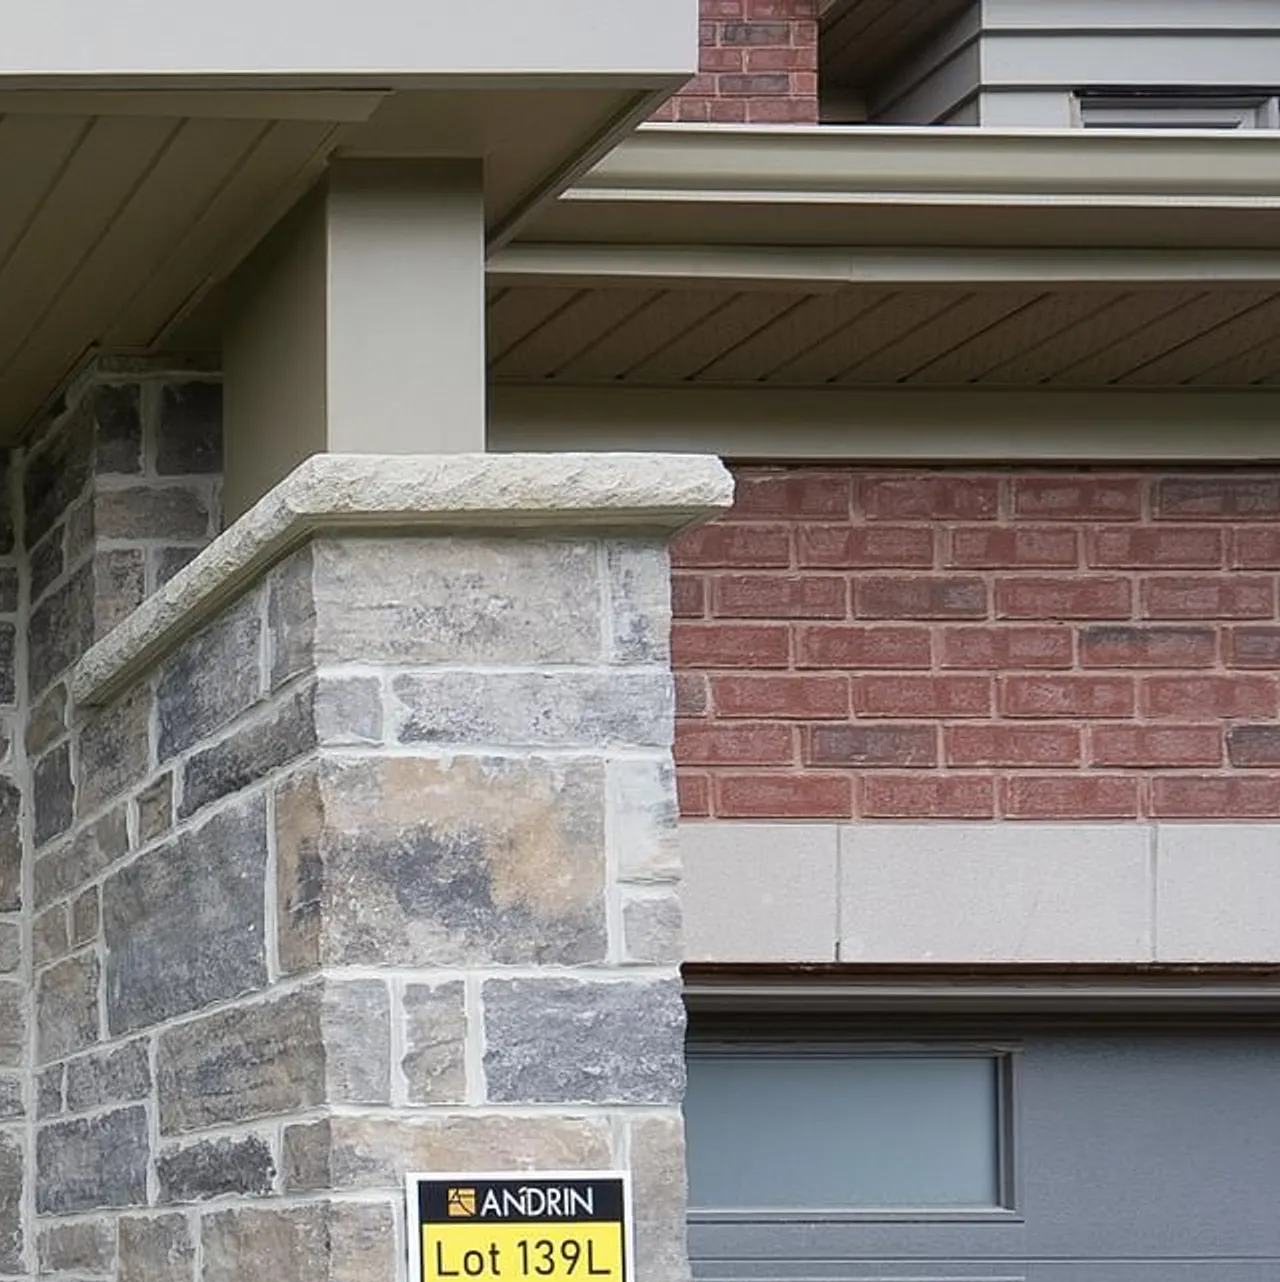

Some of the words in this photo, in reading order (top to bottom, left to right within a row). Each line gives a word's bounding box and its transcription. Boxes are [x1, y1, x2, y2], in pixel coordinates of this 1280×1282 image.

[480, 1186, 594, 1217] ANDRIN
[436, 1240, 501, 1277] Lot
[517, 1239, 612, 1276] 139L
